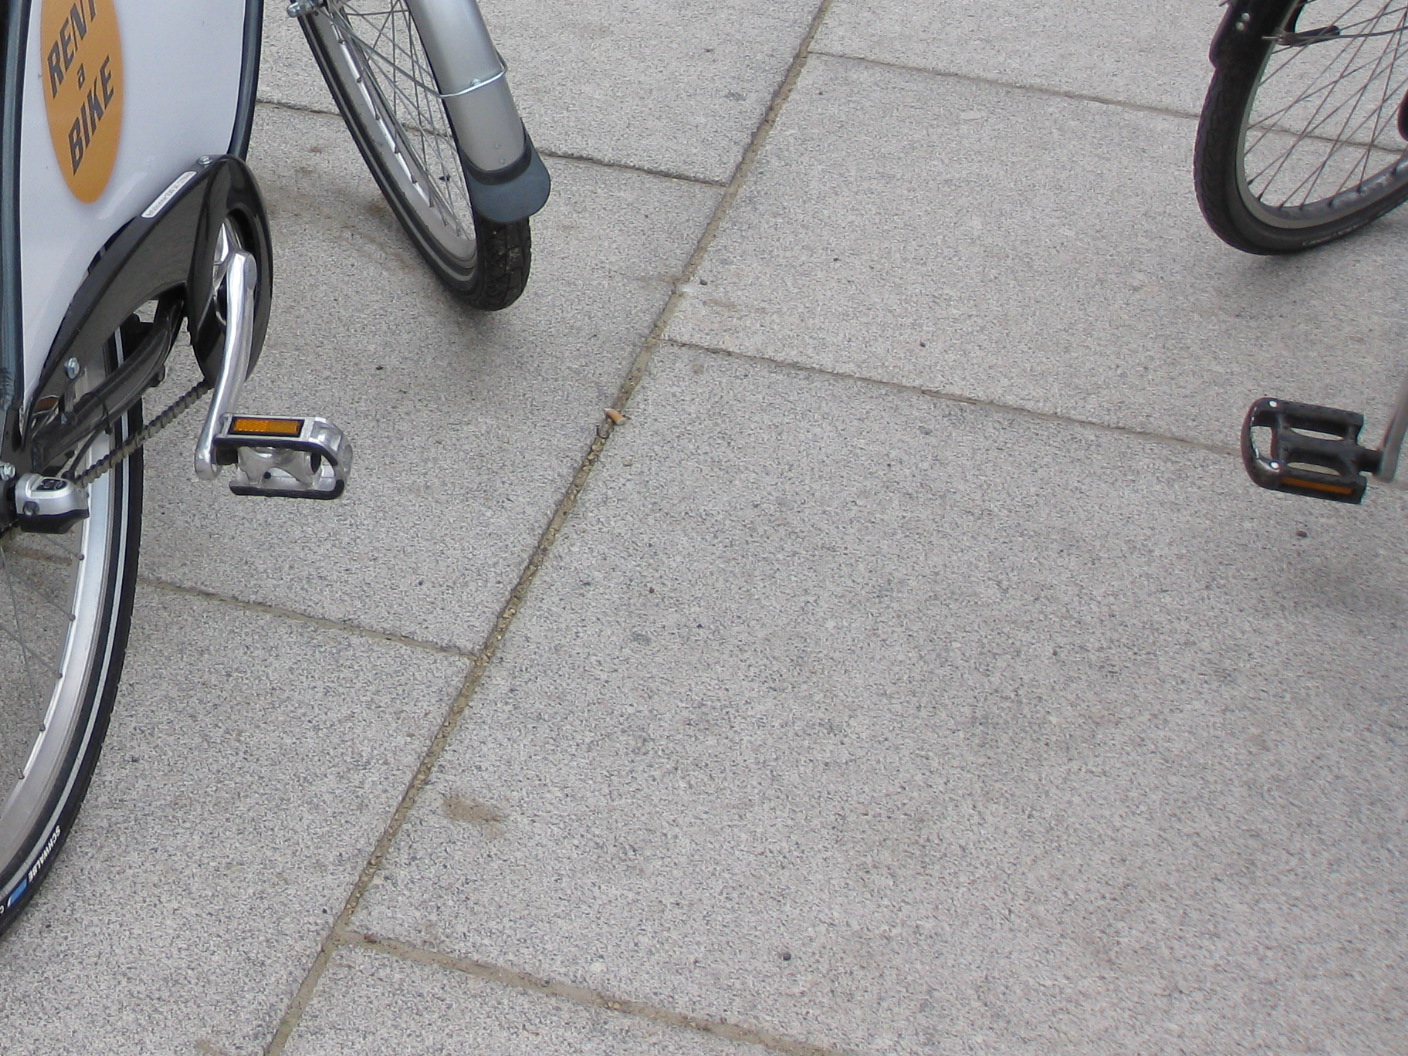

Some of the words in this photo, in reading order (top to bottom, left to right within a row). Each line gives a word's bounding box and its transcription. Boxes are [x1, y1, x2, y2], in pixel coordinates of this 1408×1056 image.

[77, 62, 86, 91] a
[68, 55, 115, 176] BIKE
[28, 825, 61, 882] SCHWALBE
